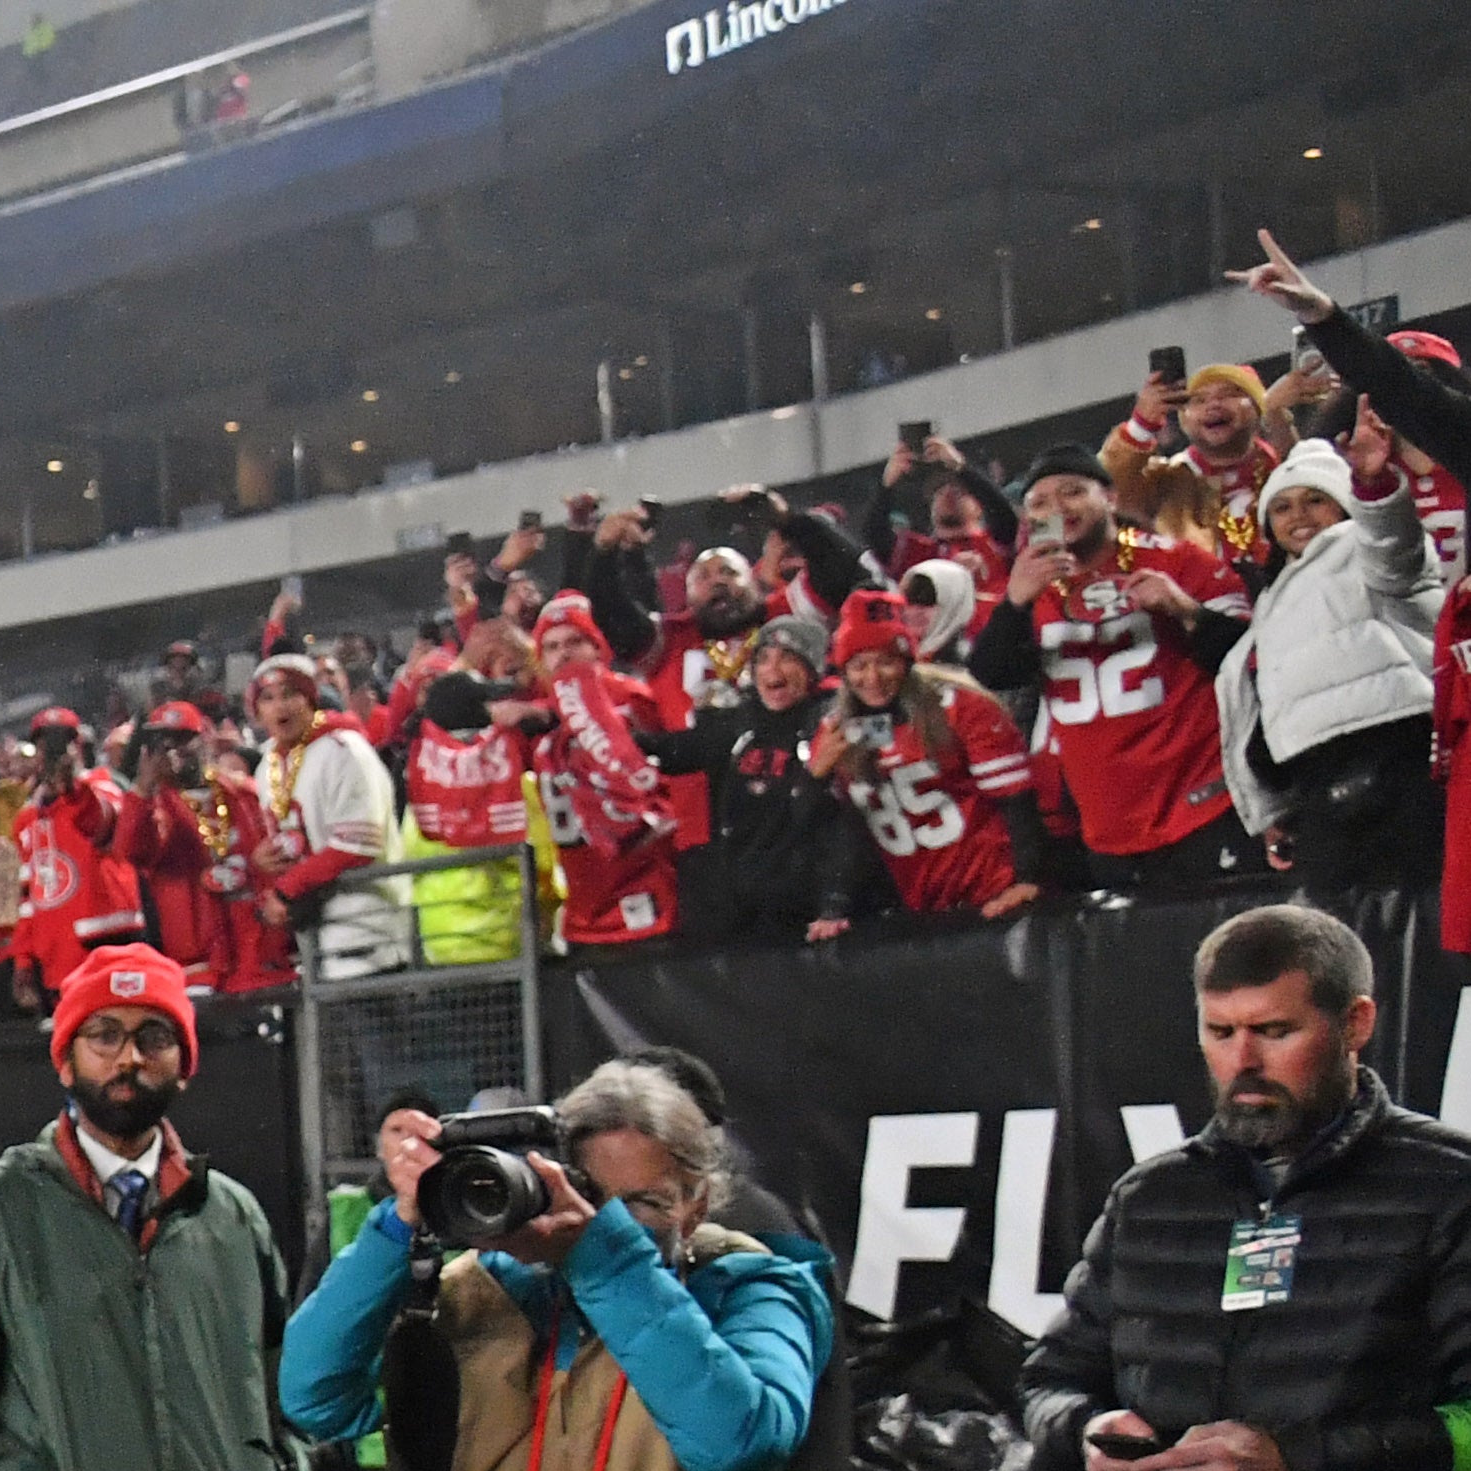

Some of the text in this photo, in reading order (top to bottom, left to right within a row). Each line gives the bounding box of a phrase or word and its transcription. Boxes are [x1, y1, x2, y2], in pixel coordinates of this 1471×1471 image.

[704, 0, 847, 58] Linco
[1040, 610, 1164, 725] 52
[848, 760, 964, 857] 85
